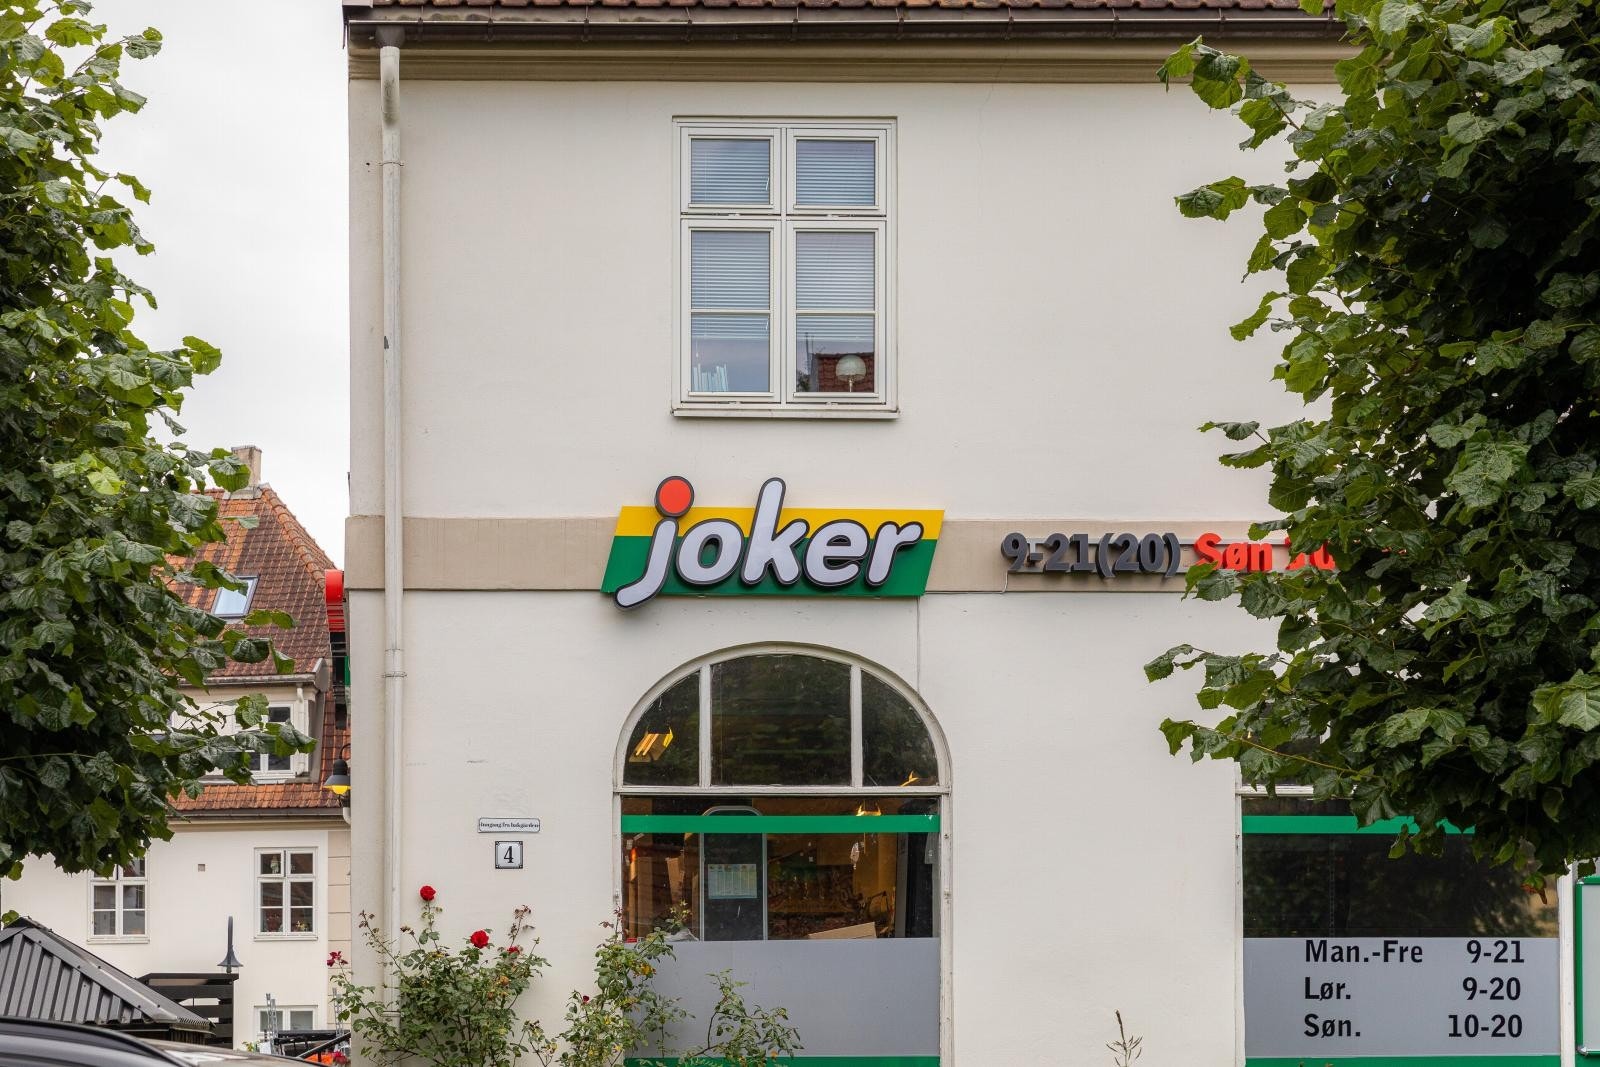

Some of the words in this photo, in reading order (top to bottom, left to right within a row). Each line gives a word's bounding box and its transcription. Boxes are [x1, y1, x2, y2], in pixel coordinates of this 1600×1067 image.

[614, 476, 925, 610] joker
[1001, 532, 1181, 578] 9-21(20)
[1193, 532, 1273, 571] Søn
[503, 846, 514, 863] 4
[1304, 939, 1423, 963] Man.-Fre
[1466, 939, 1525, 963] 9-21
[1304, 976, 1351, 1001] Lør.
[1462, 976, 1521, 1000] 9-20
[1303, 1013, 1361, 1038] Søn.
[1448, 1013, 1523, 1038] 10-20
